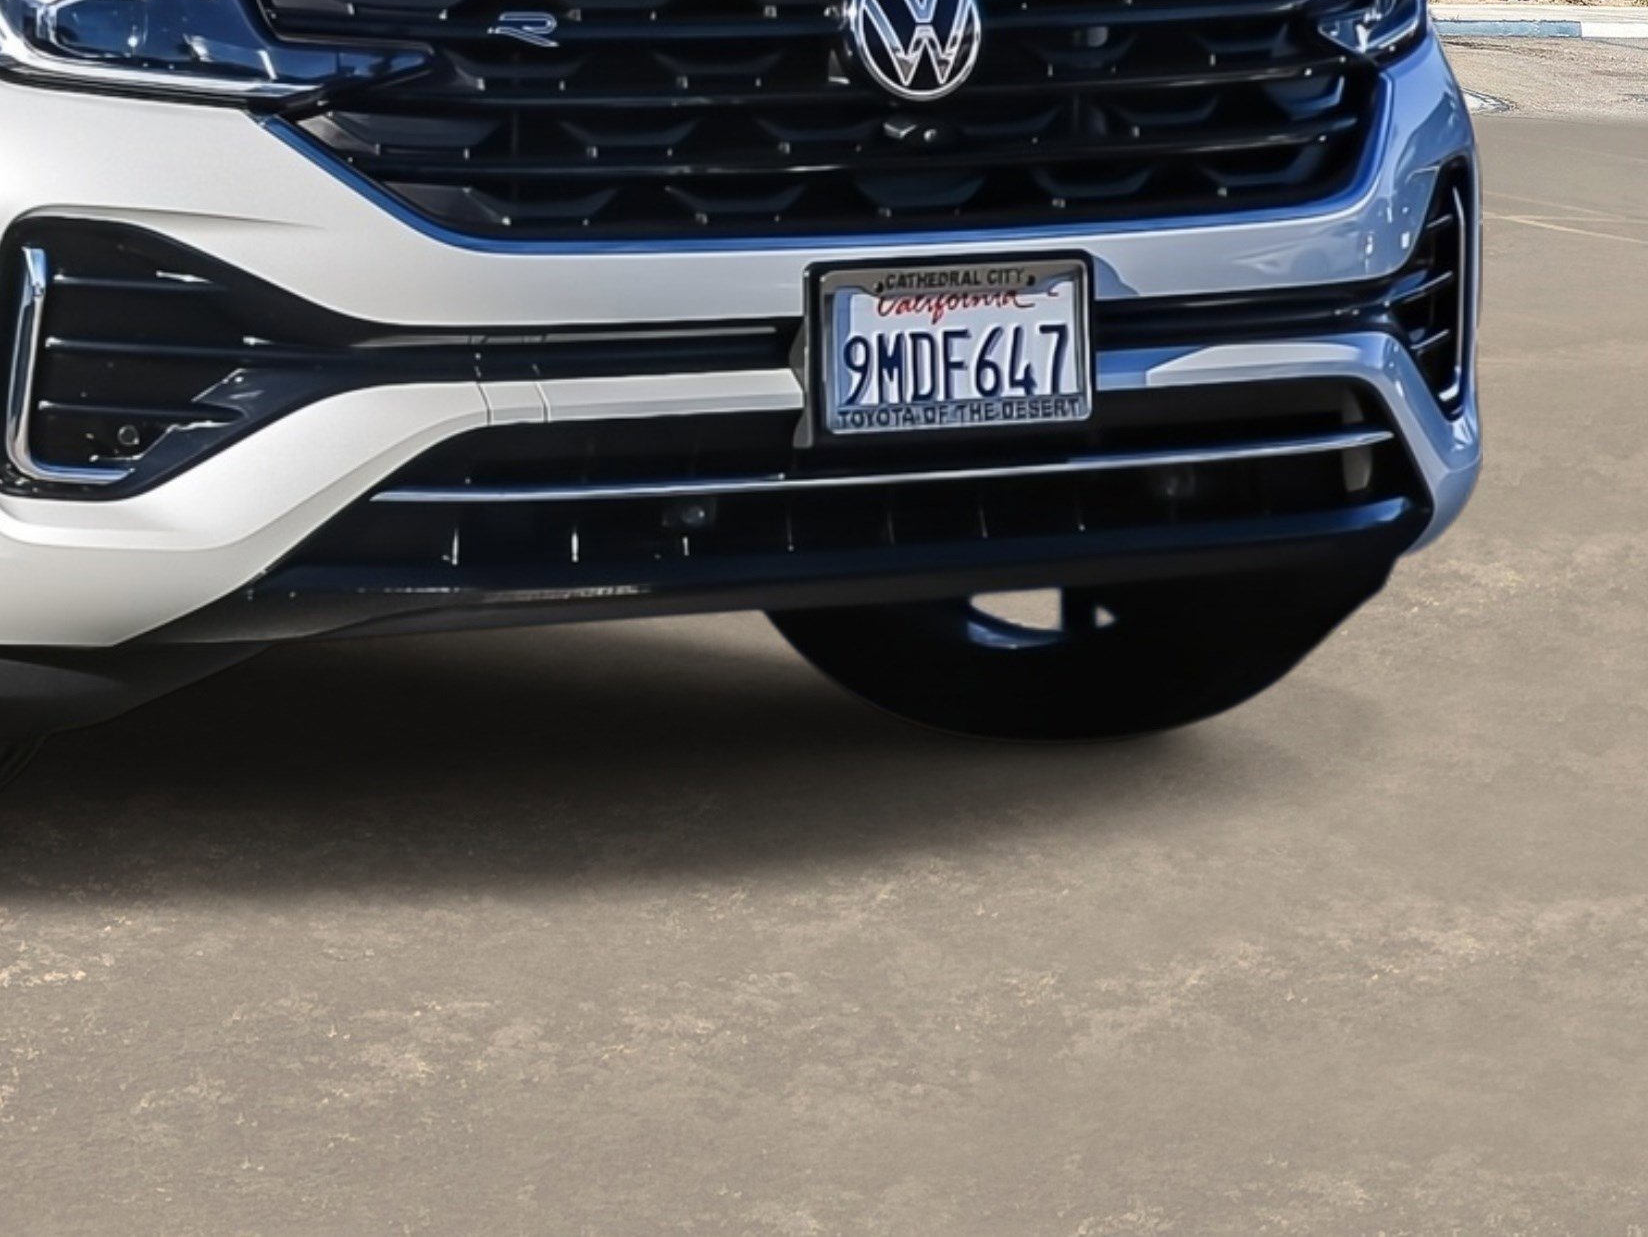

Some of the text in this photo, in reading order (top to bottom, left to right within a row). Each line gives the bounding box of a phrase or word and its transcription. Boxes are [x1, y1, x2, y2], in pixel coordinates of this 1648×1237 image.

[883, 267, 1025, 291] CATHEDRAL CITY
[877, 289, 1036, 325] California
[841, 323, 1069, 407] 9MDF647
[838, 398, 1080, 430] TOYOTA OF THE DESERT
